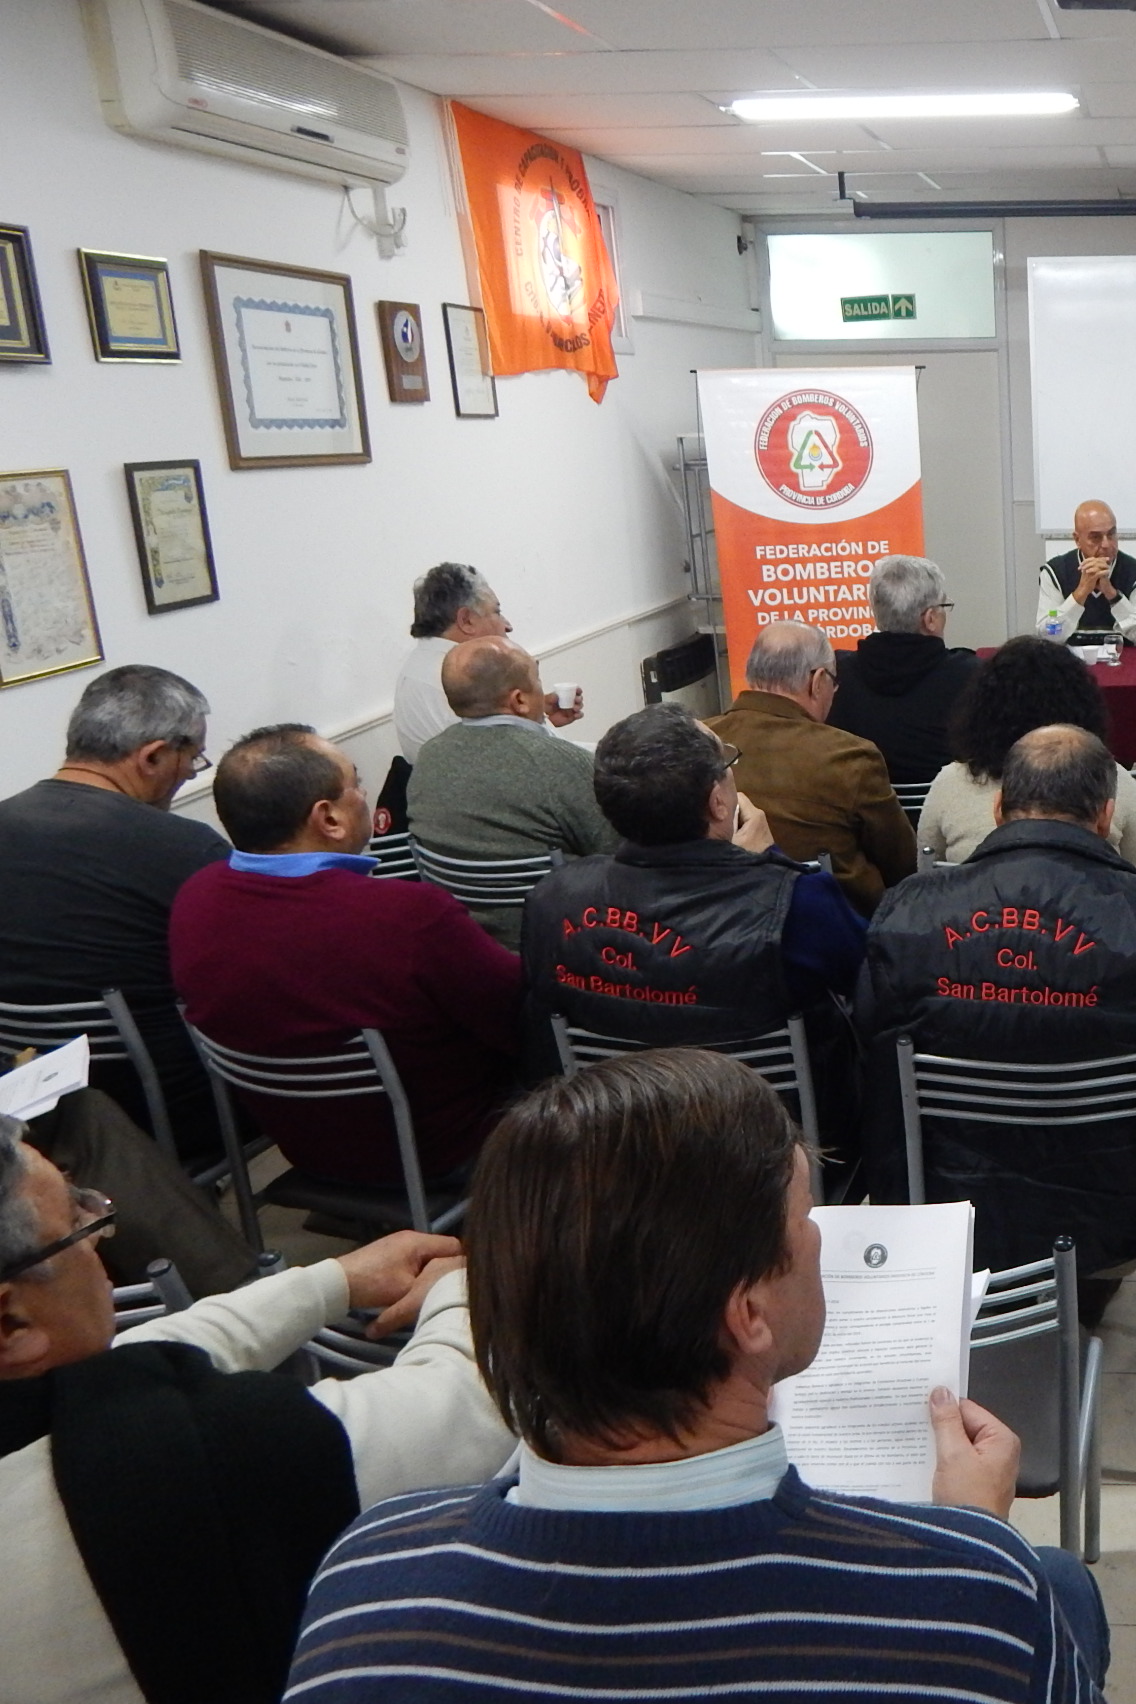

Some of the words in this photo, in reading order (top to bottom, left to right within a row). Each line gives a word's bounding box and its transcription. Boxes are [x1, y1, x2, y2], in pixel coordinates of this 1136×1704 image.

[844, 302, 888, 316] SALIDA
[760, 406, 782, 450] FEDERACION
[780, 400, 794, 410] DE
[792, 393, 834, 406] BOMBEROS
[834, 401, 869, 448] VOLUNTARIOS
[779, 484, 815, 505] PROVINCIA
[816, 496, 826, 505] DE
[756, 539, 862, 560] FEDERACIÓN
[868, 540, 890, 554] DE
[748, 584, 870, 606] VOLUNTARI
[757, 612, 780, 625] DE
[784, 610, 805, 622] LA
[808, 606, 874, 622] PROVIN
[602, 946, 637, 971] Col.
[997, 948, 1038, 970] Col.
[556, 964, 586, 990] San
[590, 976, 697, 1006] Bartolomé
[937, 977, 974, 1000] San
[982, 982, 1098, 1008] Bartolomé
